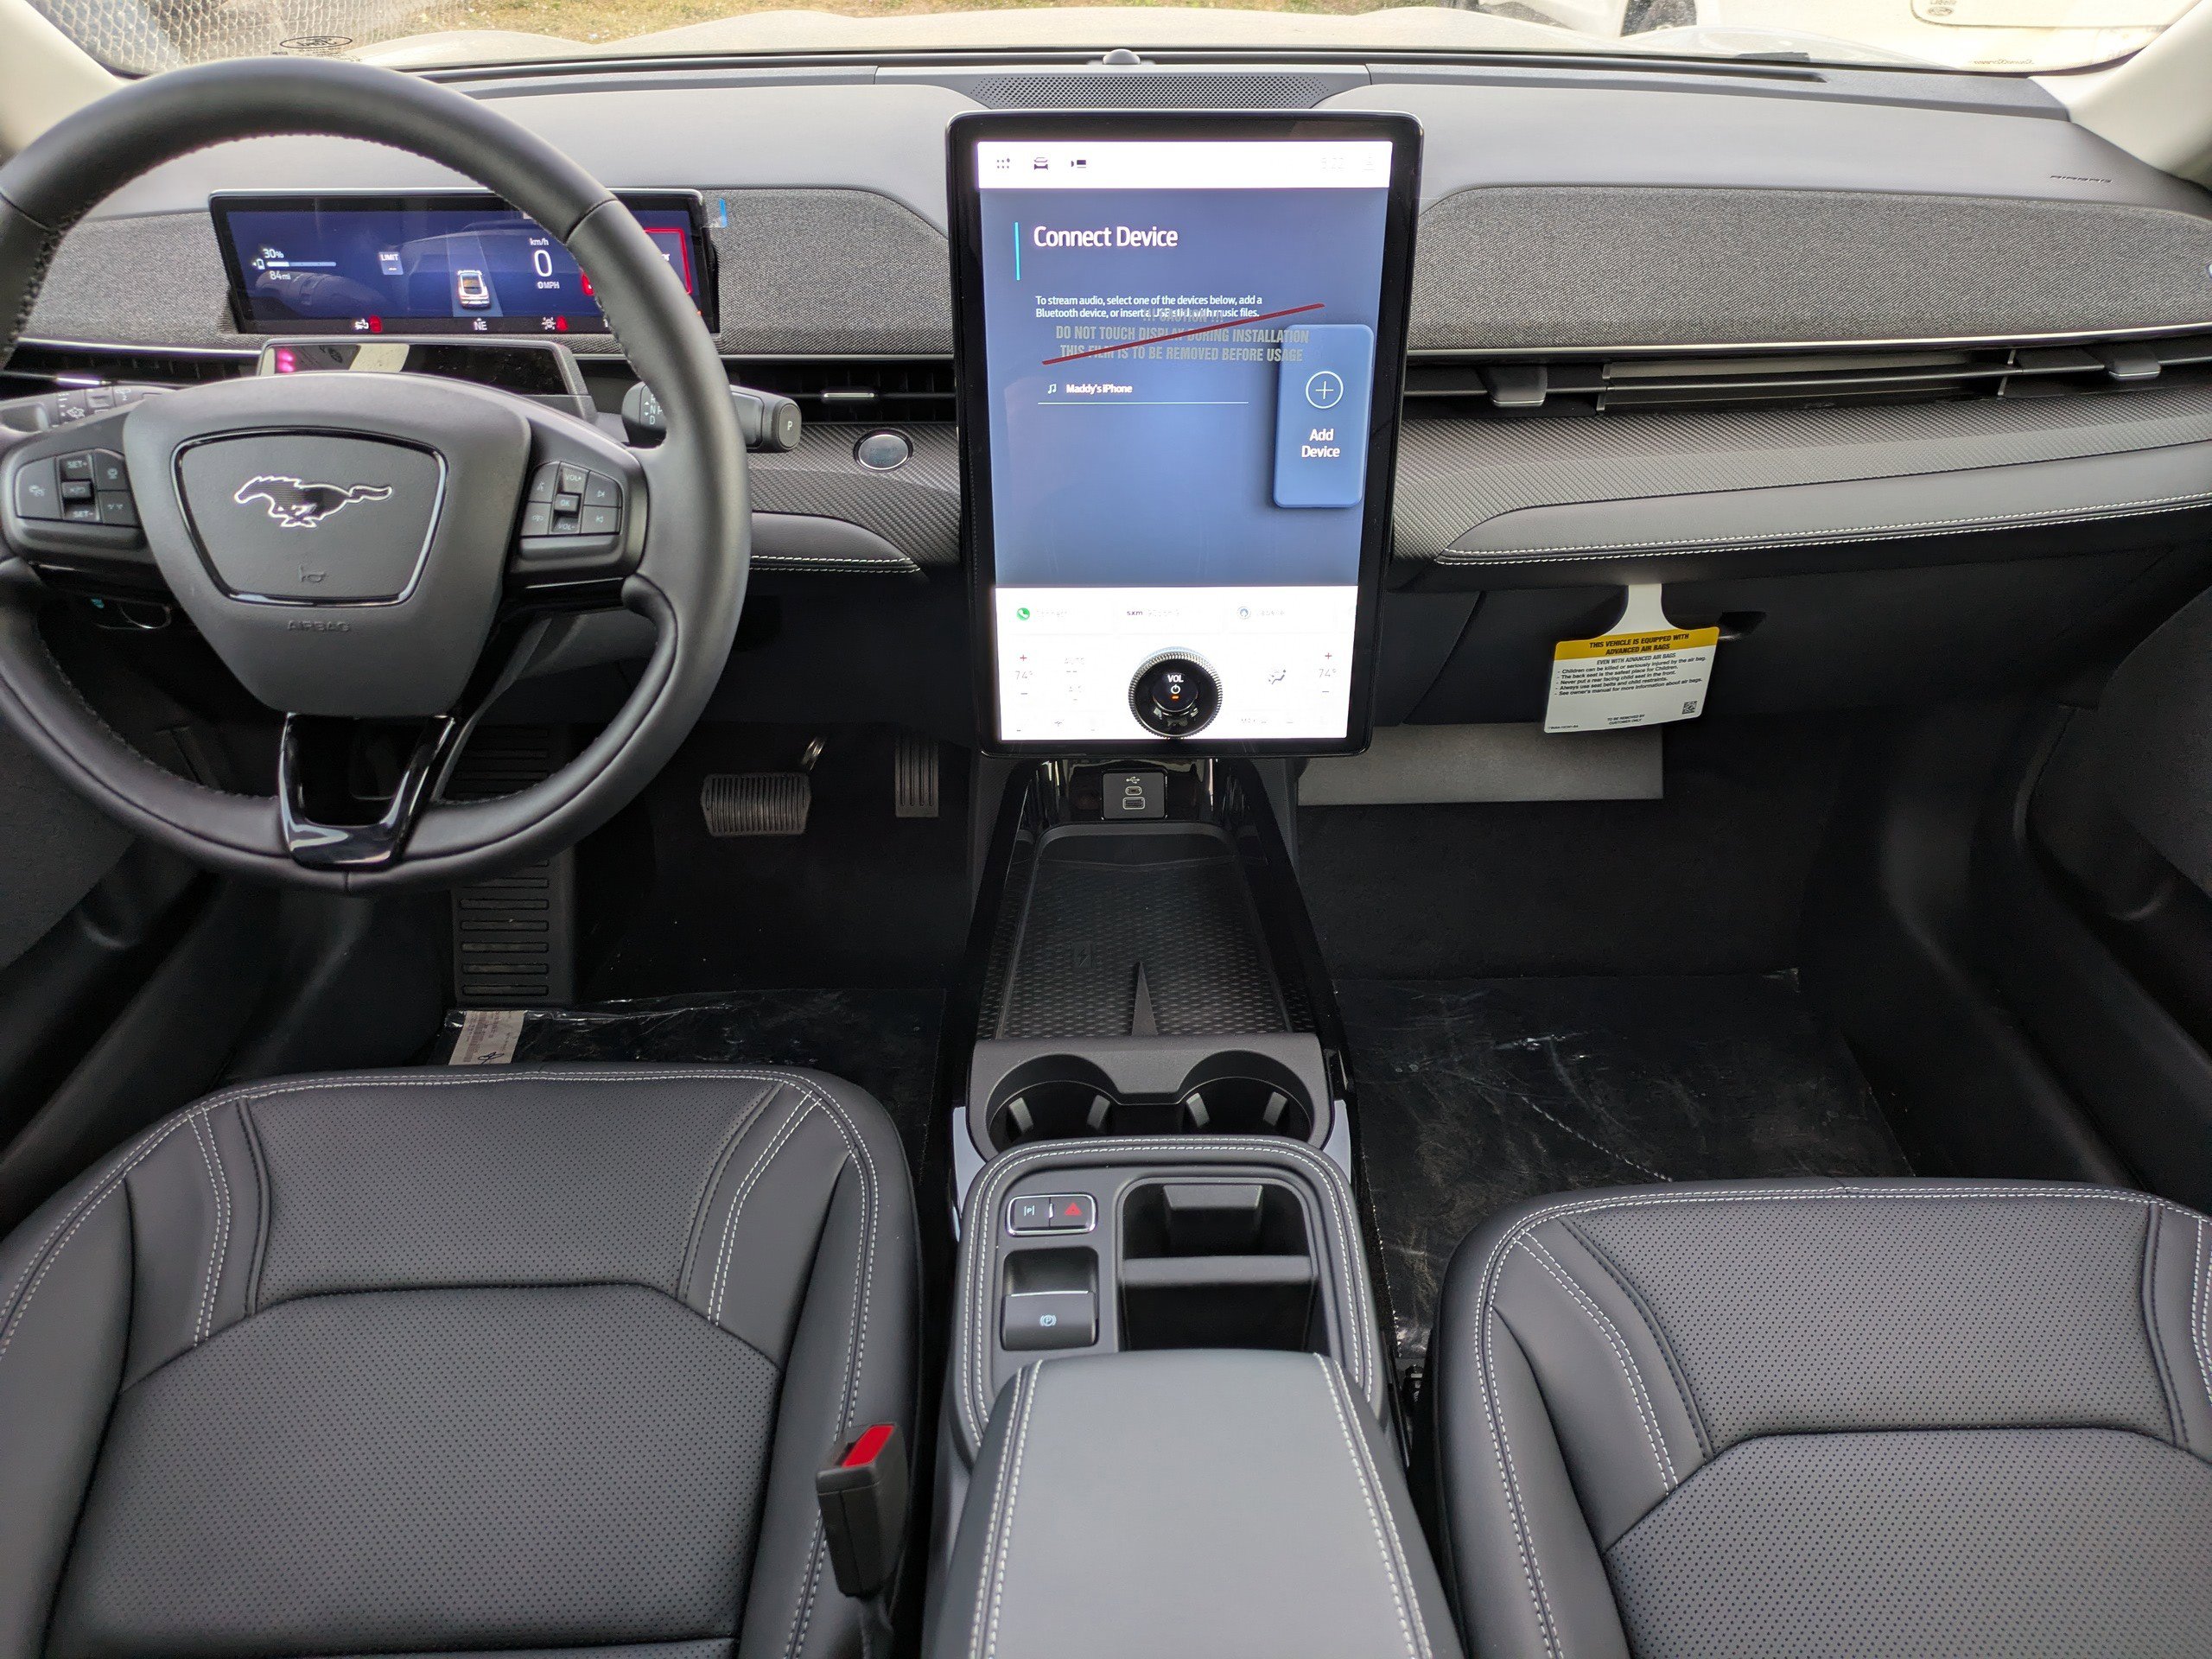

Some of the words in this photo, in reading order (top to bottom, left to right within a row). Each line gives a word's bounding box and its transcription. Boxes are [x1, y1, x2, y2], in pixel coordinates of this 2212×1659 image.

[530, 238, 549, 246] km/h
[1033, 226, 1111, 247] Connect
[1116, 226, 1179, 247] Device
[263, 248, 284, 258] 30%
[534, 250, 553, 277] 0
[1035, 296, 1046, 305] To
[1048, 296, 1077, 305] stream
[1079, 296, 1105, 306] audio,
[1107, 296, 1132, 305] select
[1151, 296, 1160, 305] of
[1161, 296, 1175, 305] the
[1177, 296, 1208, 305] devices
[1210, 295, 1237, 306] below,
[1239, 295, 1255, 304] add
[1036, 308, 1078, 318] Bluetooth
[1079, 308, 1109, 319] device,
[1121, 308, 1143, 317] insert
[1239, 308, 1260, 317] files.
[474, 321, 488, 330] NE
[1056, 326, 1071, 339] DO
[1074, 327, 1096, 340] NOT
[1100, 327, 1135, 340] TOUCH
[1232, 329, 1309, 343] INSTALLATION
[1060, 345, 1085, 357] THIS
[1117, 346, 1128, 359] IS
[1132, 346, 1146, 359] TO
[1148, 346, 1163, 359] BE
[1166, 347, 1218, 360] REMOVED
[1222, 348, 1263, 361] BEFORE
[1267, 348, 1303, 361] USAGE
[1065, 384, 1102, 395] Maddy's
[1103, 384, 1133, 393] iPhone
[650, 405, 656, 414] N
[650, 416, 656, 424] D
[787, 421, 793, 430] P
[1309, 428, 1334, 441] Add
[1301, 445, 1340, 458] Device
[1605, 646, 1639, 655] ADVANCED
[1167, 674, 1184, 683] VOL
